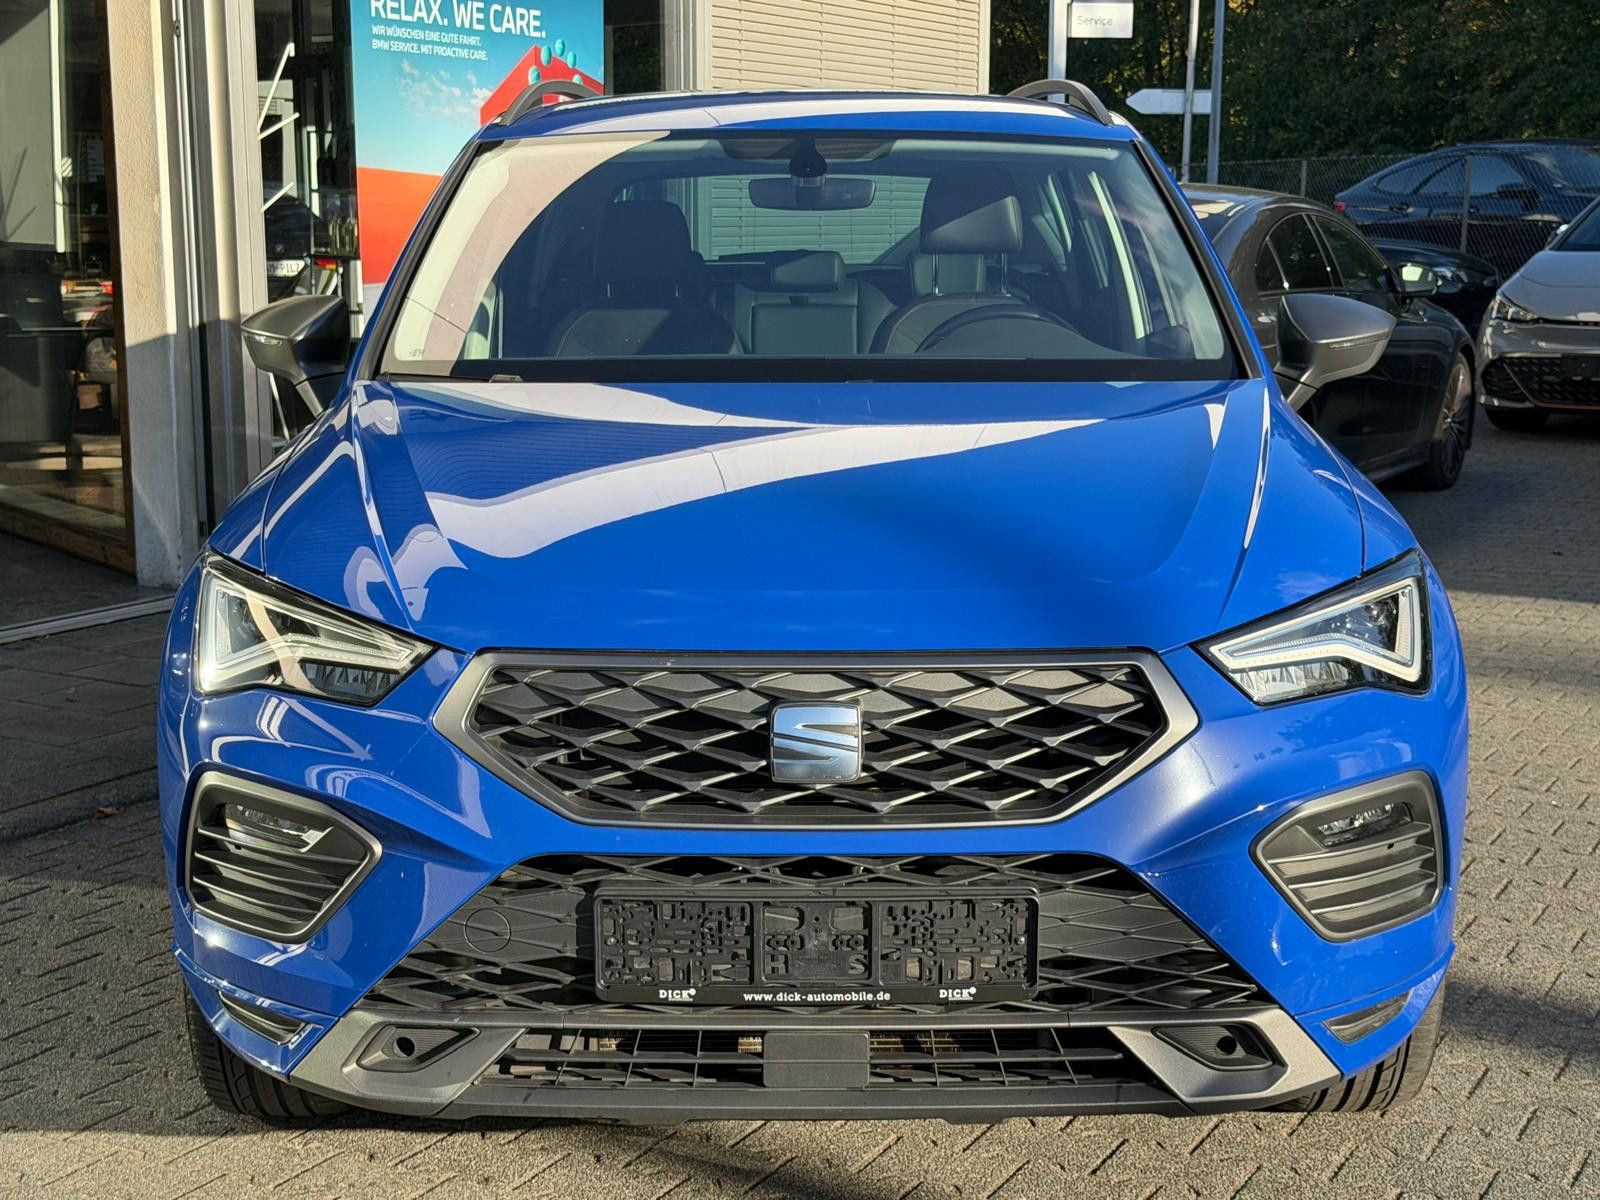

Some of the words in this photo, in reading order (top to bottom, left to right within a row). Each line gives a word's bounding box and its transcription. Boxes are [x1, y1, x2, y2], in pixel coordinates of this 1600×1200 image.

[370, 0, 448, 26] RELAX.
[453, 0, 486, 31] WE
[489, 4, 546, 38] CARE.
[1077, 15, 1113, 26] Service
[372, 25, 385, 36] WIR
[386, 25, 424, 40] WÜNSCHEN
[425, 30, 440, 42] EINE
[441, 32, 459, 44] GUTE
[372, 39, 390, 51] BMW
[421, 44, 433, 55] MIT
[433, 45, 469, 59] PROACTIVE
[659, 988, 695, 999] DICK
[743, 991, 891, 1002] www.dick-automobile.de
[939, 988, 974, 998] DICK
